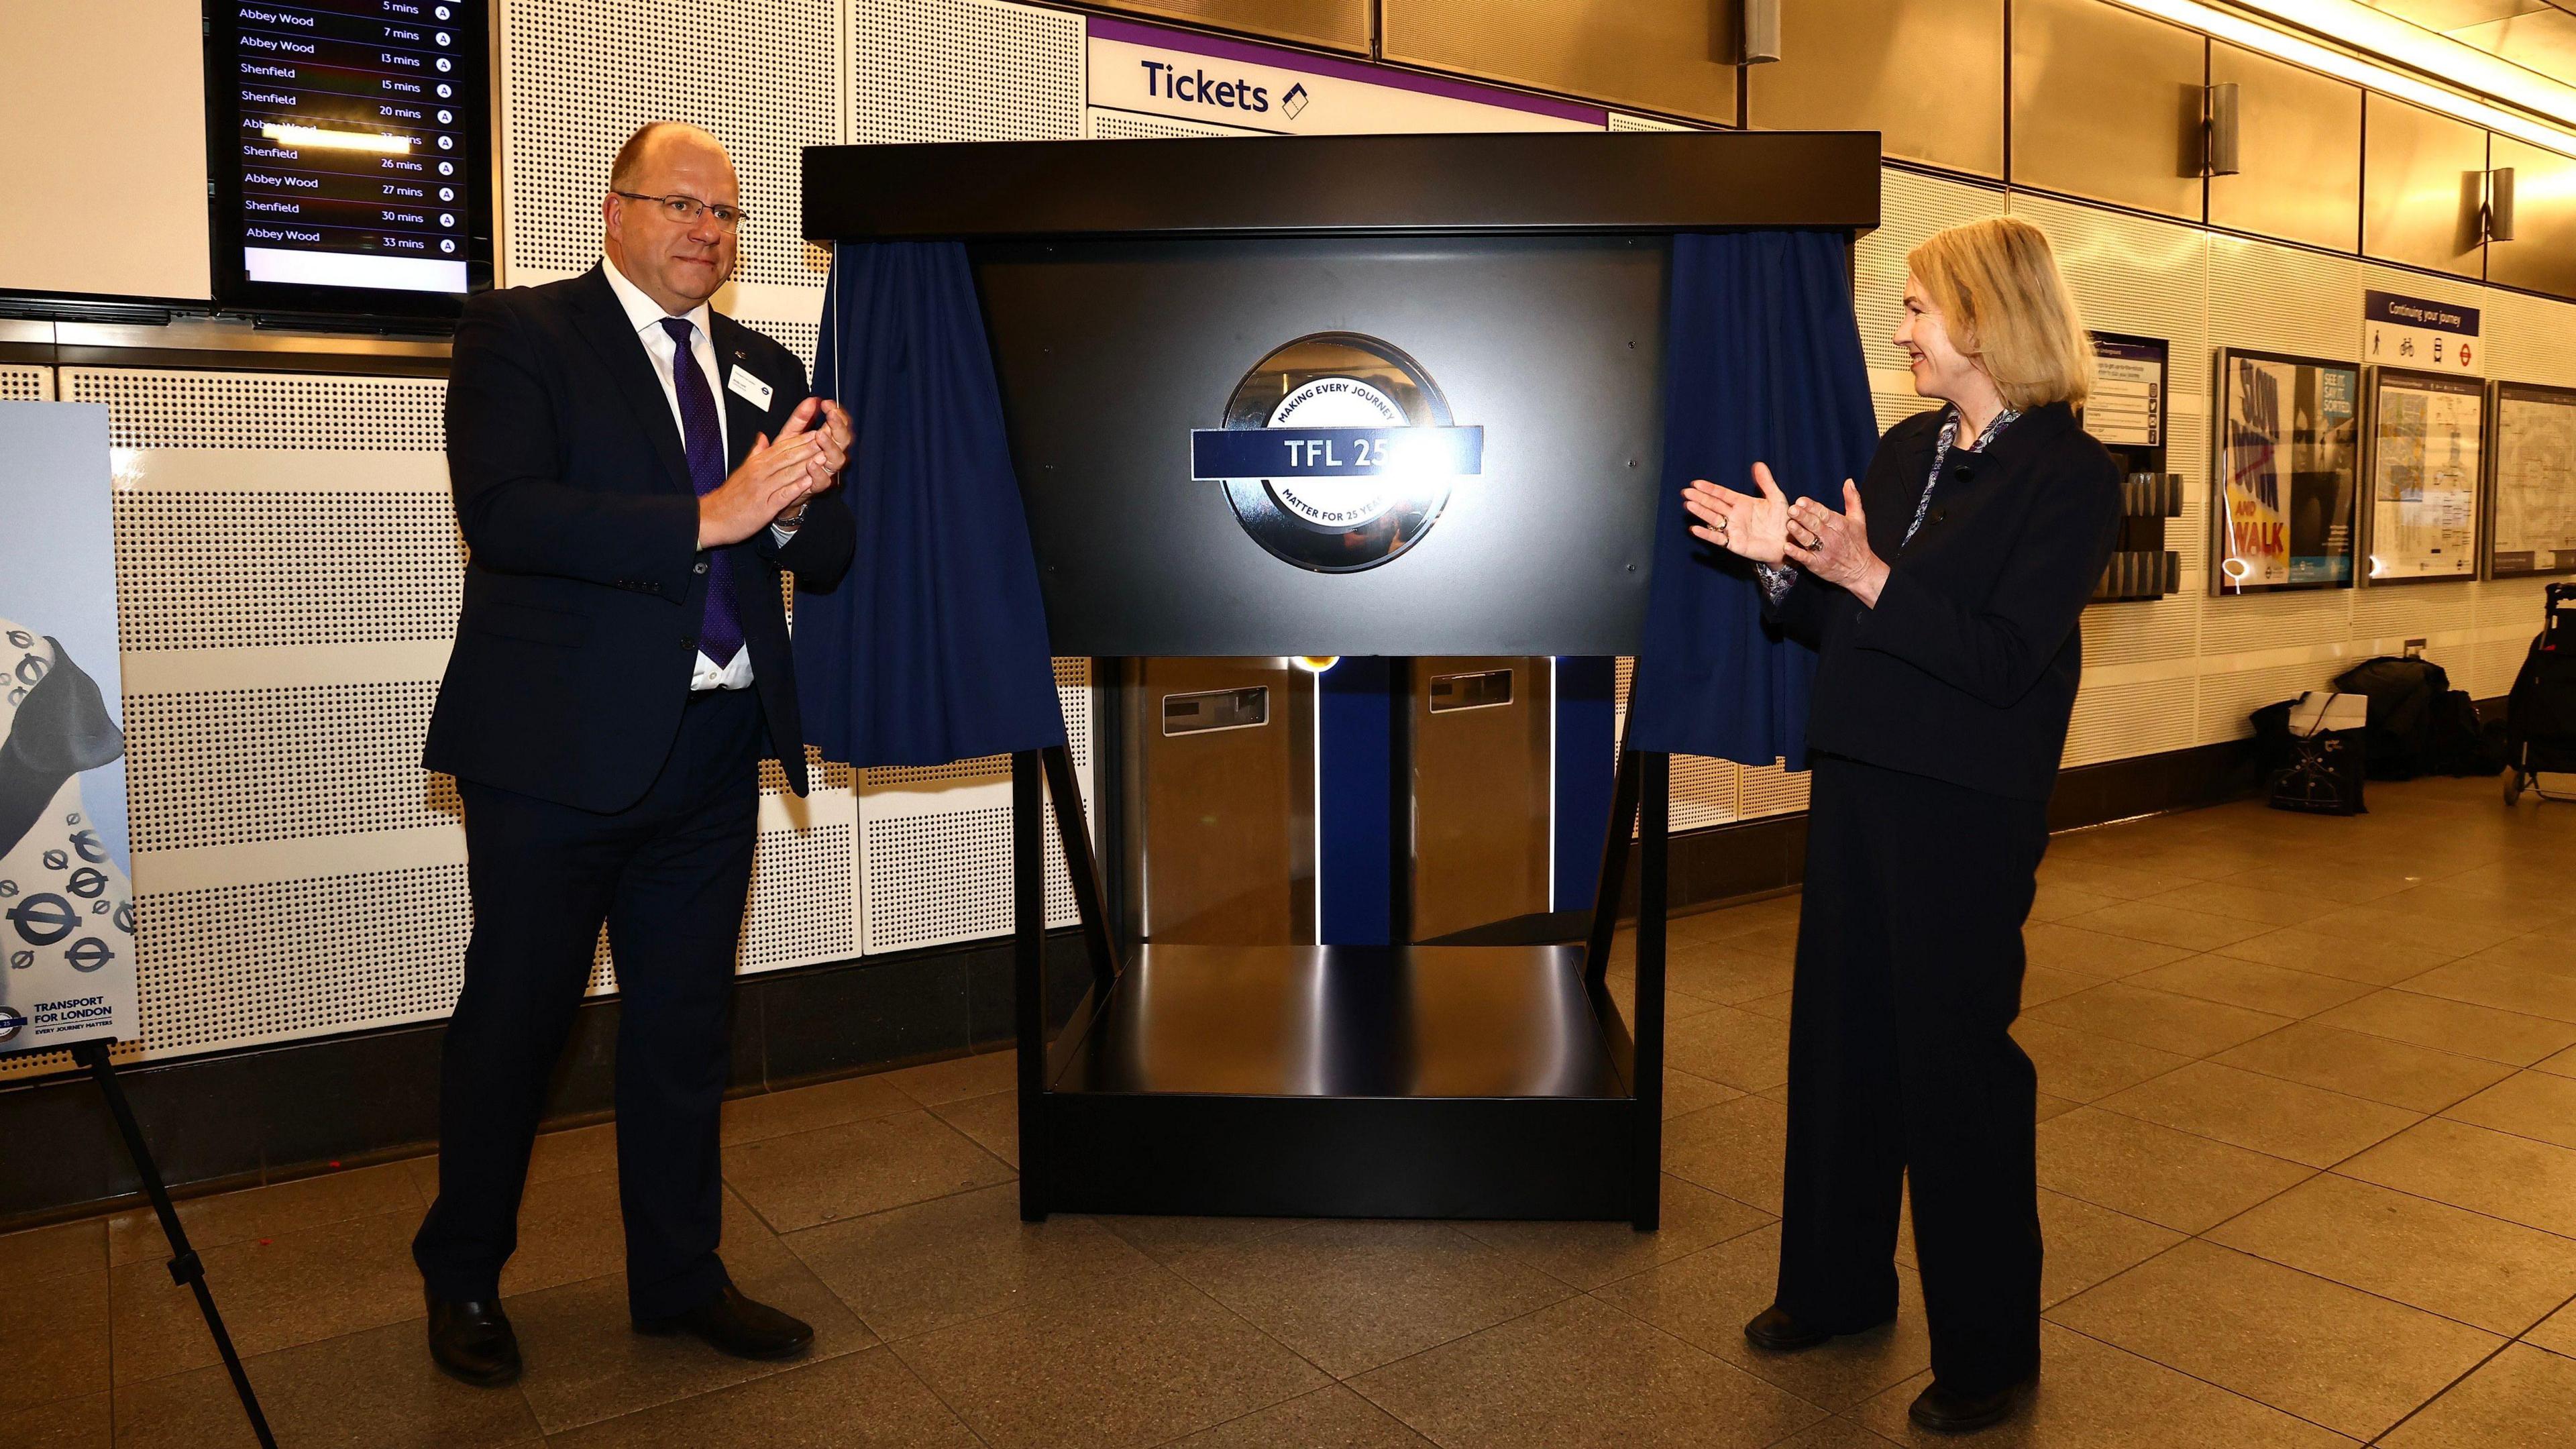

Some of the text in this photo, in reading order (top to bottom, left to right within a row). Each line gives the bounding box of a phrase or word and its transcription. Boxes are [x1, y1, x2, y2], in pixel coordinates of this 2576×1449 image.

[382, 1, 390, 10] 5
[392, 3, 419, 14] mins
[239, 9, 276, 23] Abbey
[279, 13, 314, 26] Wood
[384, 27, 391, 36] 7
[393, 30, 420, 40] mins
[240, 36, 278, 50] Abbey
[280, 40, 315, 54] Wood
[381, 53, 391, 63] 13
[393, 56, 421, 66] mins
[241, 63, 295, 78] Shenfield
[382, 80, 392, 89] 15
[394, 83, 421, 93] mins
[1141, 60, 1269, 113] Tickets
[241, 91, 297, 105] Shenfield
[379, 105, 392, 115] 20
[394, 109, 421, 119] mins
[244, 146, 298, 160] Shenfield
[381, 158, 394, 168] 26
[396, 161, 423, 171] mins
[244, 173, 282, 186] Abbey
[284, 176, 319, 188] Wood
[382, 185, 394, 195] 27
[397, 187, 423, 197] mins
[246, 200, 299, 213] Shenfield
[382, 211, 395, 221] 30
[397, 213, 424, 223] mins
[246, 228, 284, 241] Abbey
[286, 230, 320, 241] Wood
[383, 237, 396, 246] 33
[398, 239, 425, 249] mins
[2389, 302, 2461, 327] Continuing your journey
[1278, 384, 1395, 423] MAKING EVERY JOURNEY
[1284, 439, 1390, 467] TFL 25
[1283, 489, 1319, 518] MATTER
[1322, 512, 1344, 521] FOR
[1346, 511, 1358, 520] 25
[2235, 501, 2256, 517] AND
[2235, 522, 2284, 553] WALK
[34, 996, 103, 1012] TRANSPORT
[35, 1006, 111, 1024] FOR LONDON
[86, 1020, 113, 1028] MATTERS
